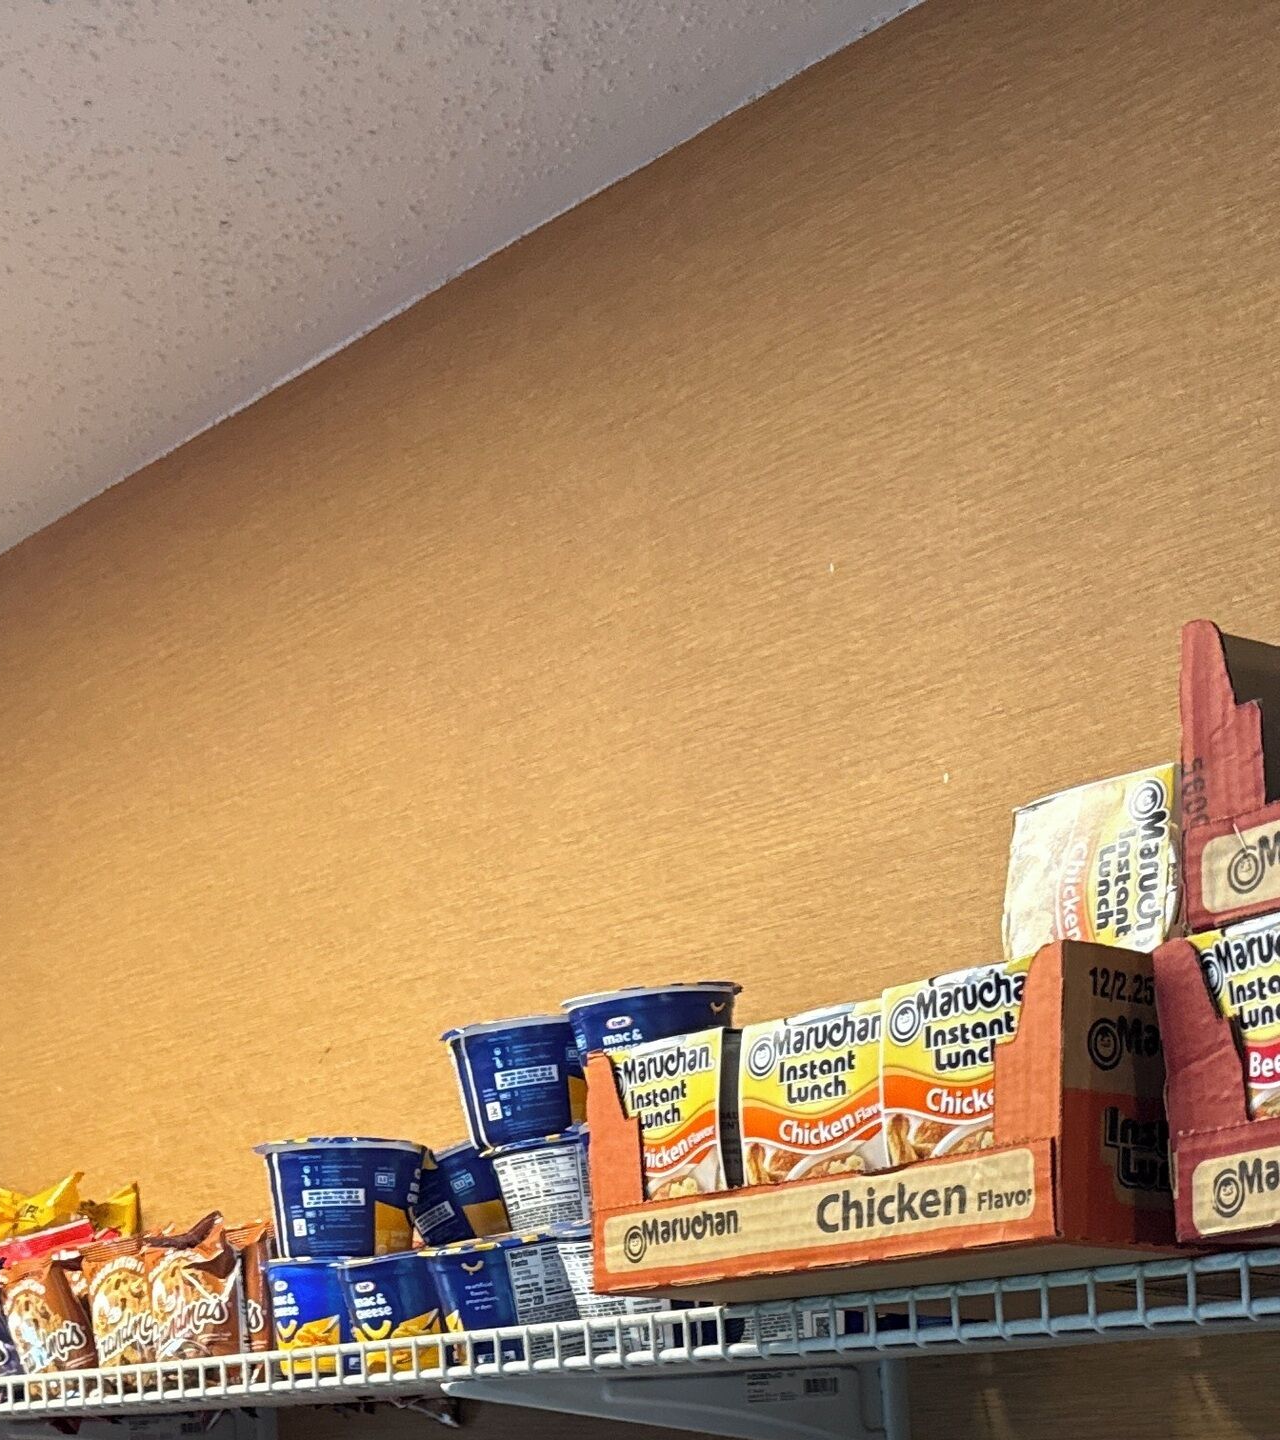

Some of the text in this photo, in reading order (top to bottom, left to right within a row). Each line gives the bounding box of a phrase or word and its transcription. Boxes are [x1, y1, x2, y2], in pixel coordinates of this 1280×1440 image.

[1095, 844, 1118, 931] Lunch
[1114, 828, 1137, 938] Instant
[602, 1031, 643, 1047] mac &
[924, 1012, 1016, 1051] Instant
[778, 1054, 856, 1086] Instant
[630, 1082, 688, 1110] Instant
[786, 1079, 847, 1105] Lunch
[778, 1111, 856, 1147] Chicken
[644, 1141, 687, 1170] hicken
[816, 1184, 1032, 1235] Chicken Flavor
